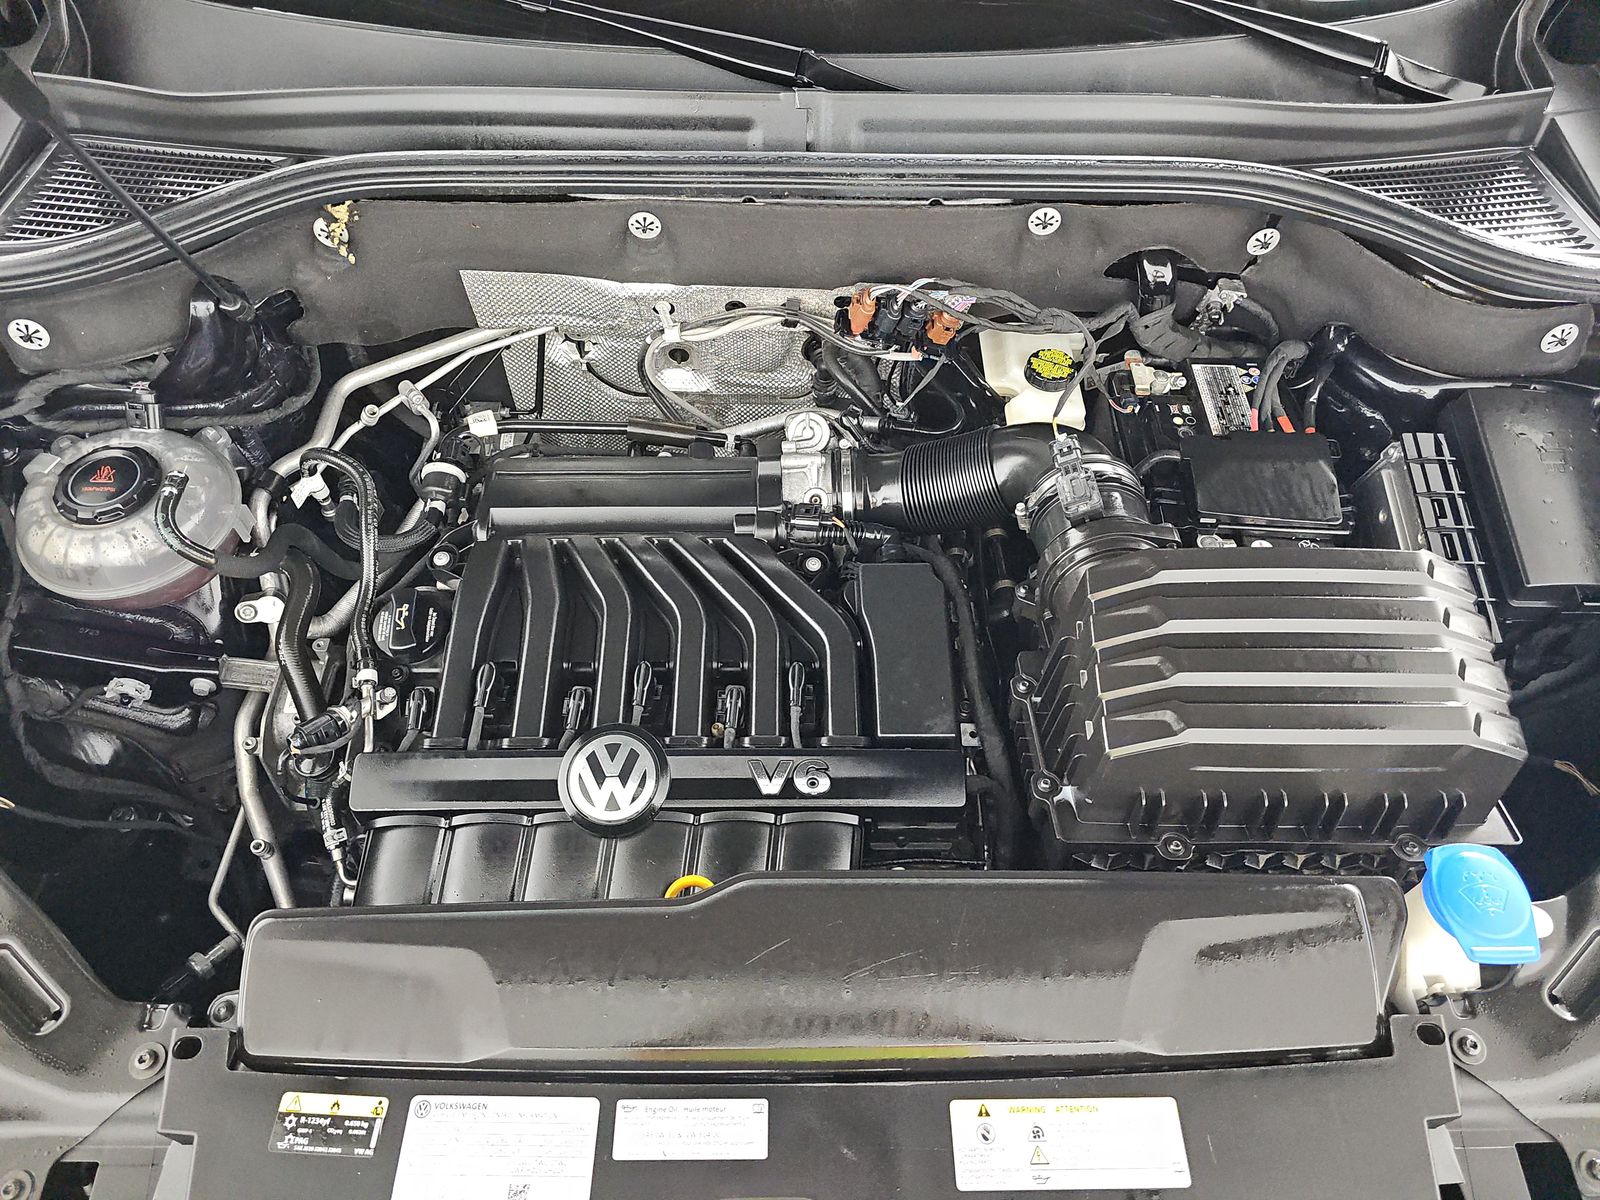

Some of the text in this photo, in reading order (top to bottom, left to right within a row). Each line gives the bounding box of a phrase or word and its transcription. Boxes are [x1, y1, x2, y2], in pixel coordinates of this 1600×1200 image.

[748, 758, 831, 796] V6
[434, 1102, 488, 1110] VOLKSWAGEN
[644, 1105, 667, 1115] Engine
[1008, 1104, 1099, 1114] WARNING ATTENTION
